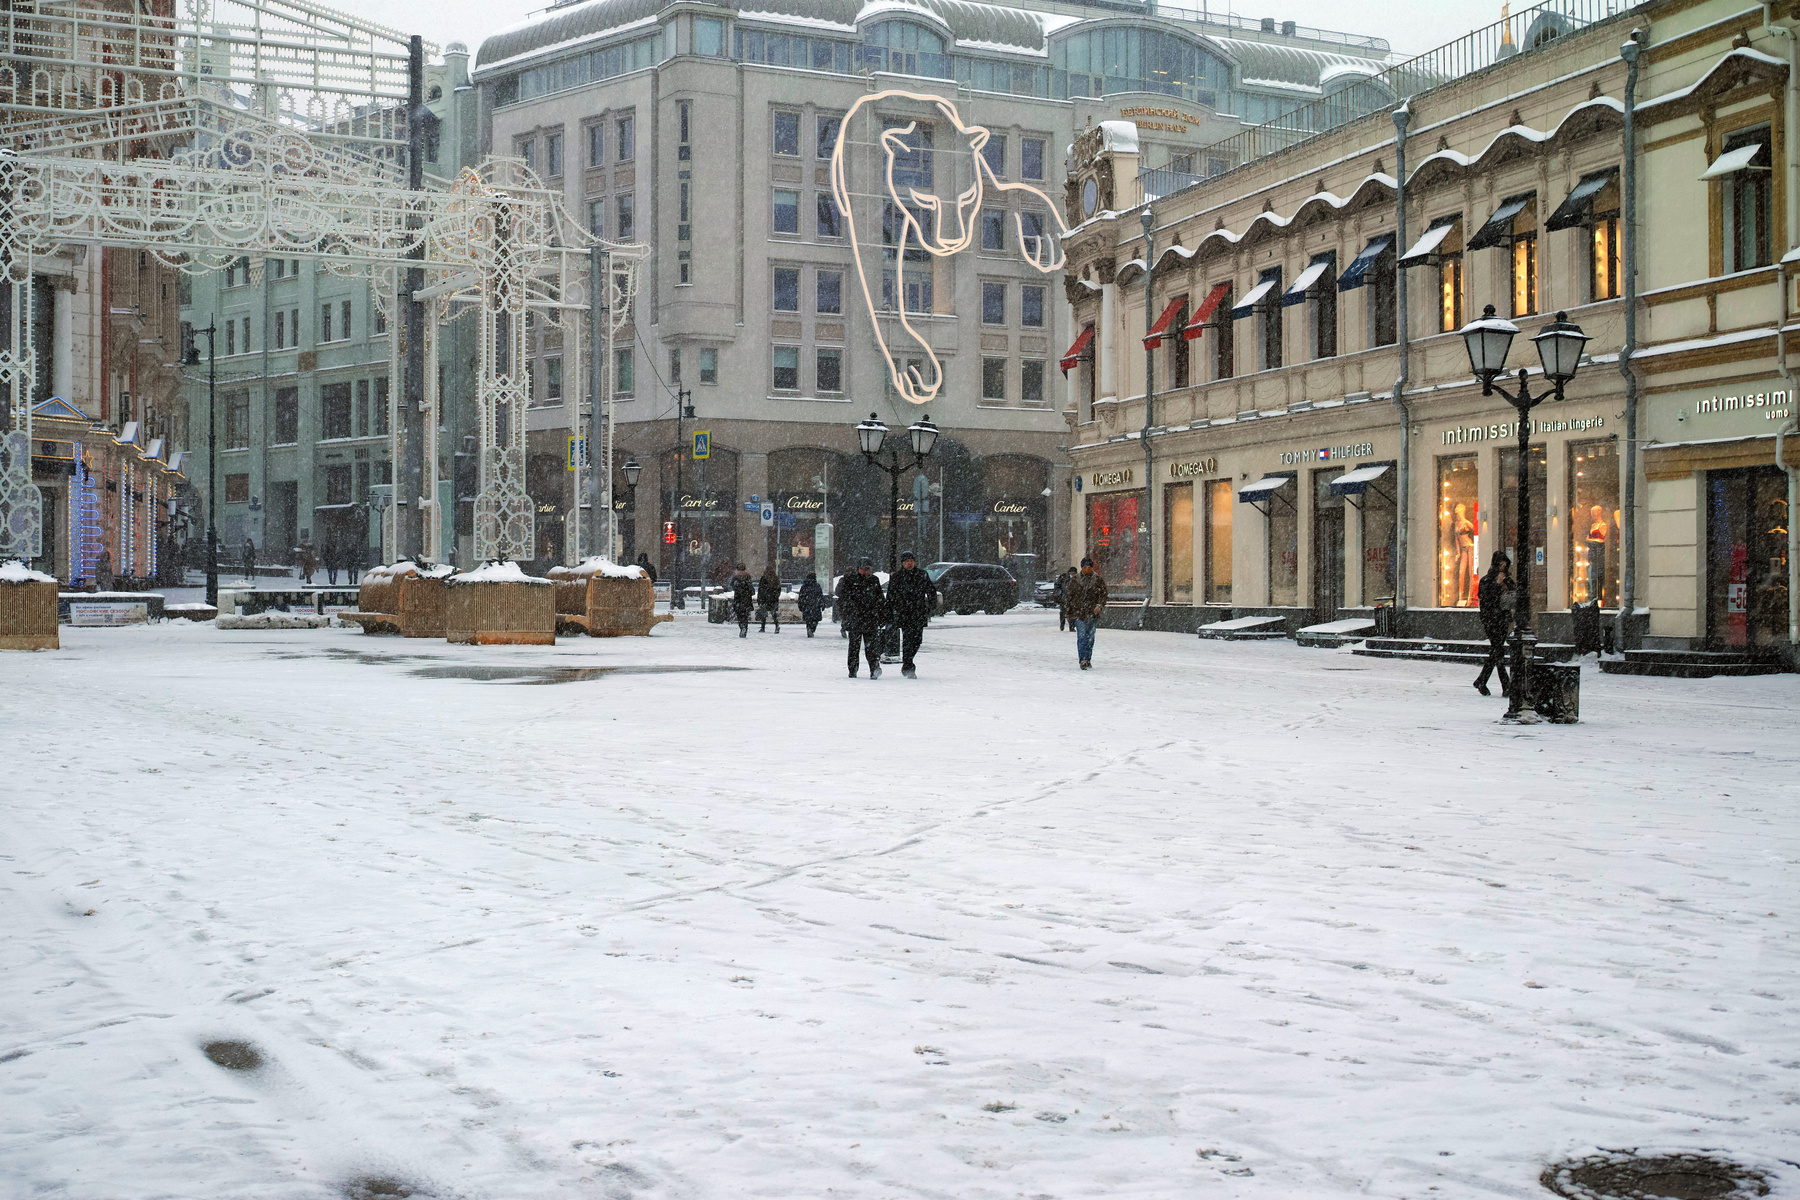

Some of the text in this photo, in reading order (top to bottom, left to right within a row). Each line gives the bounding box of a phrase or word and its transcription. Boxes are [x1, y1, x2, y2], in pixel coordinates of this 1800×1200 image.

[1121, 107, 1201, 126] БЕРЛИНСКИЙ ДОМ
[1136, 120, 1187, 133] BERLIN HAUS
[1696, 389, 1794, 414] intimissimi
[1765, 408, 1789, 419] uomo
[1540, 420, 1567, 433] Italian
[1569, 415, 1604, 432] lingerie
[1279, 442, 1374, 465] TOMMY HILFIGER
[1178, 461, 1203, 476] OMEGA
[1099, 472, 1121, 486] OMEGA
[680, 494, 718, 508] Carter
[787, 496, 824, 509] Cartier
[994, 500, 1027, 513] Cartier
[1366, 547, 1388, 562] SALE
